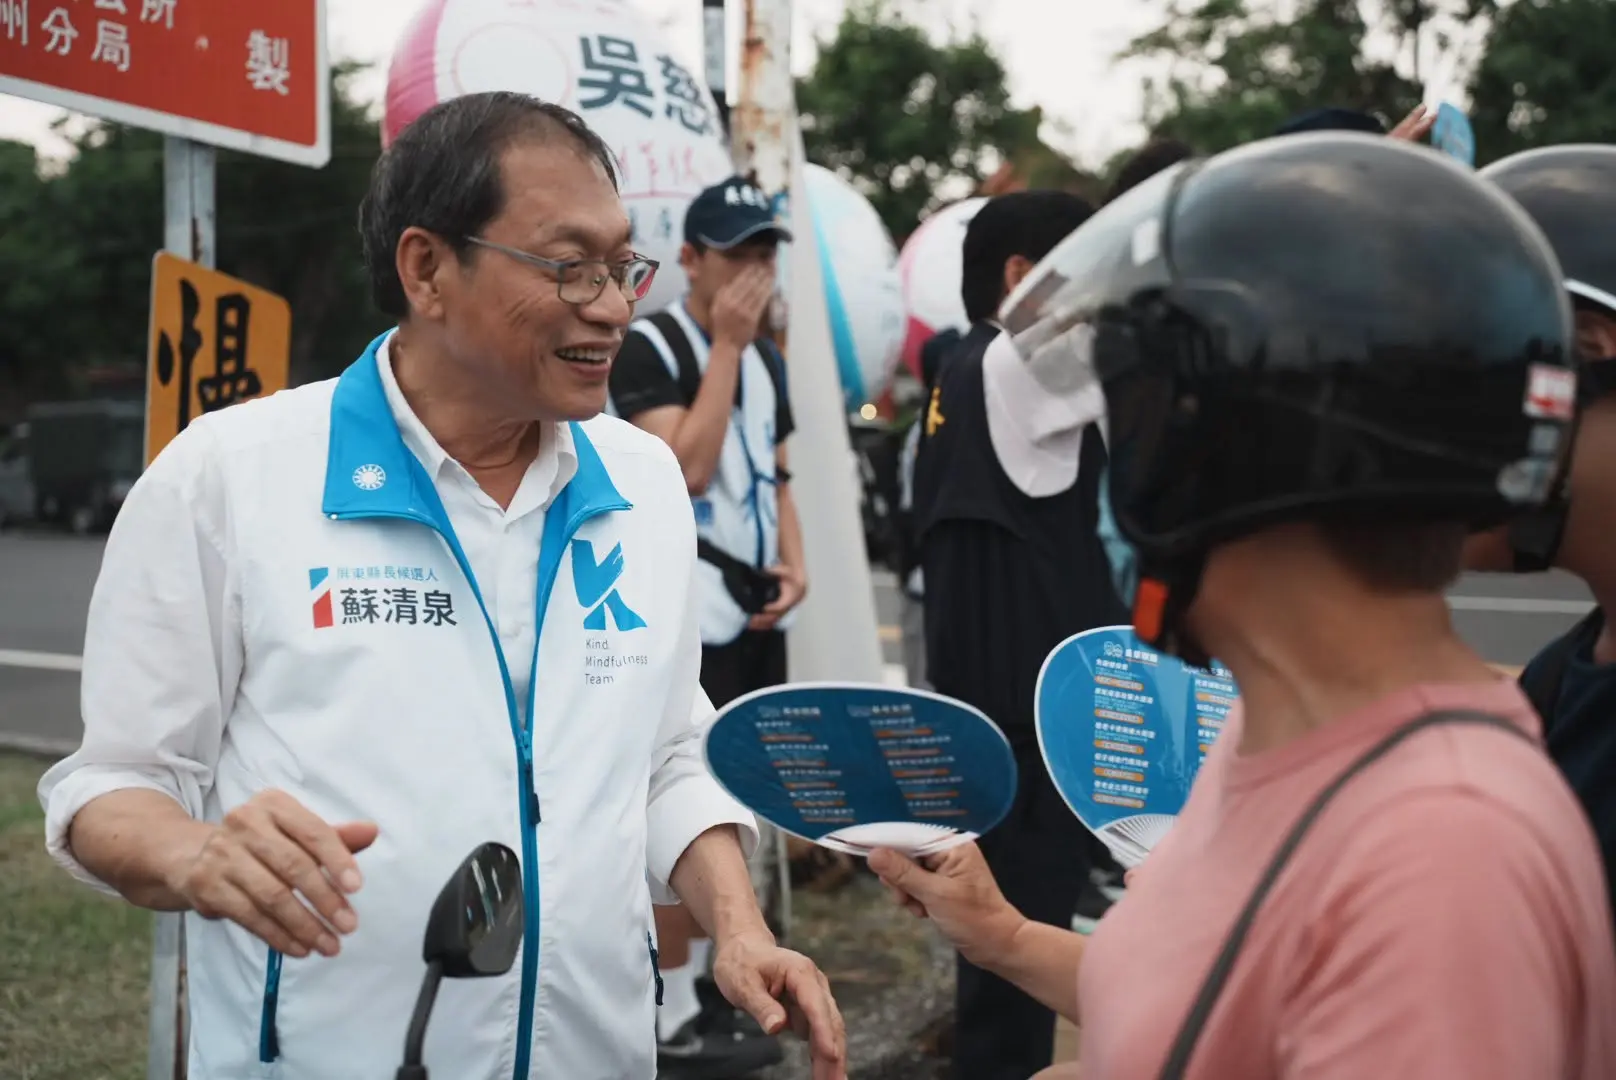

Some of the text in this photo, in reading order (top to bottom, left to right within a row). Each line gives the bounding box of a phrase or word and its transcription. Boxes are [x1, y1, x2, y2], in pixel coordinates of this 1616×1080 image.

[245, 29, 290, 95] 製
[340, 587, 458, 626] 蘇清泉
[585, 654, 648, 669] Mindfulness
[585, 672, 614, 686] Team
